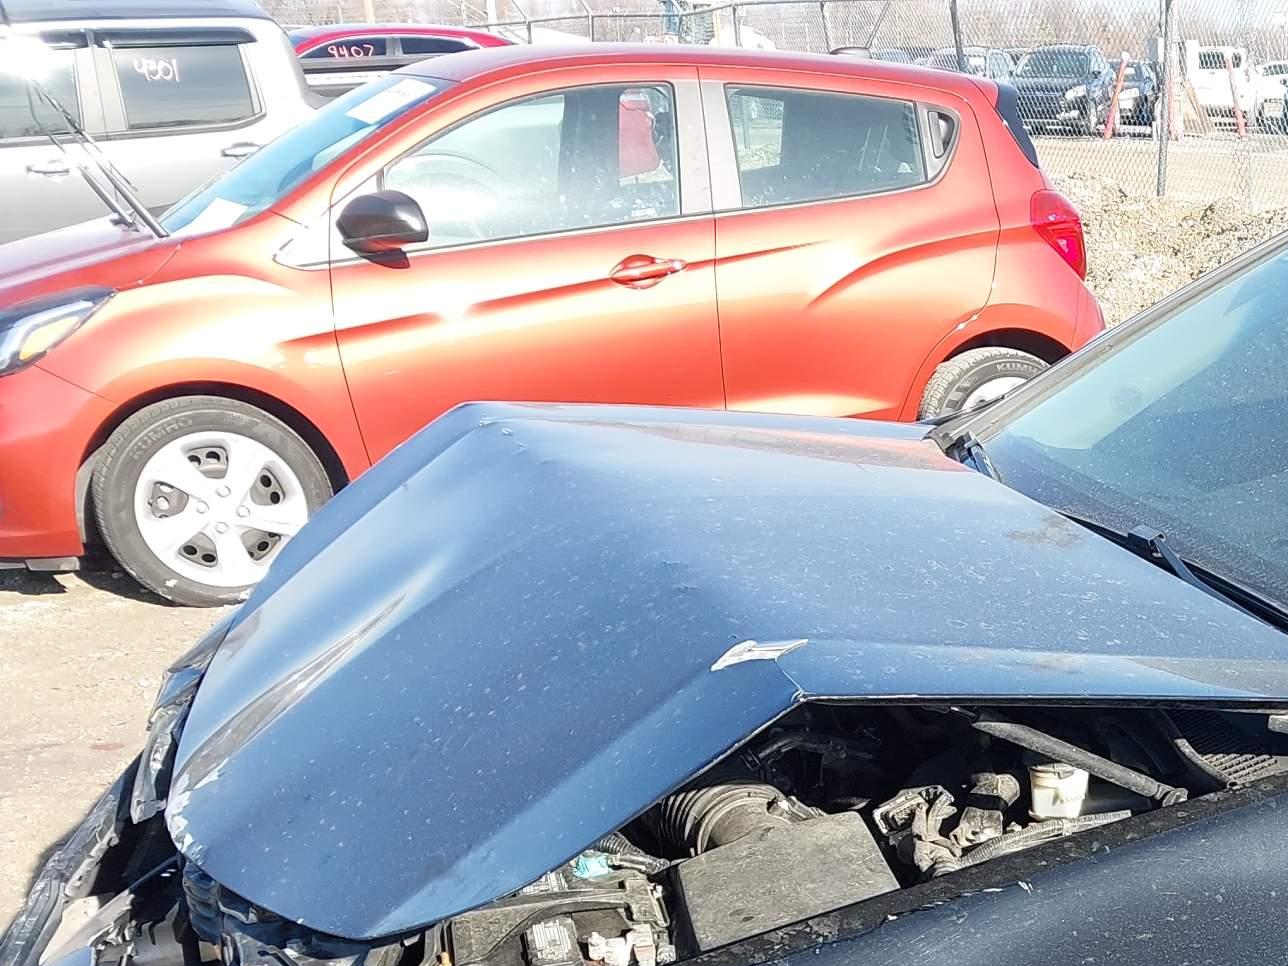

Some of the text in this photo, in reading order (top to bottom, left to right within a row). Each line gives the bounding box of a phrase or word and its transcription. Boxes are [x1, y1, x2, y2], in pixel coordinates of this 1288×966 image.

[327, 44, 374, 58] 9407
[996, 362, 1039, 375] KUMH
[129, 417, 192, 460] KUMHO
